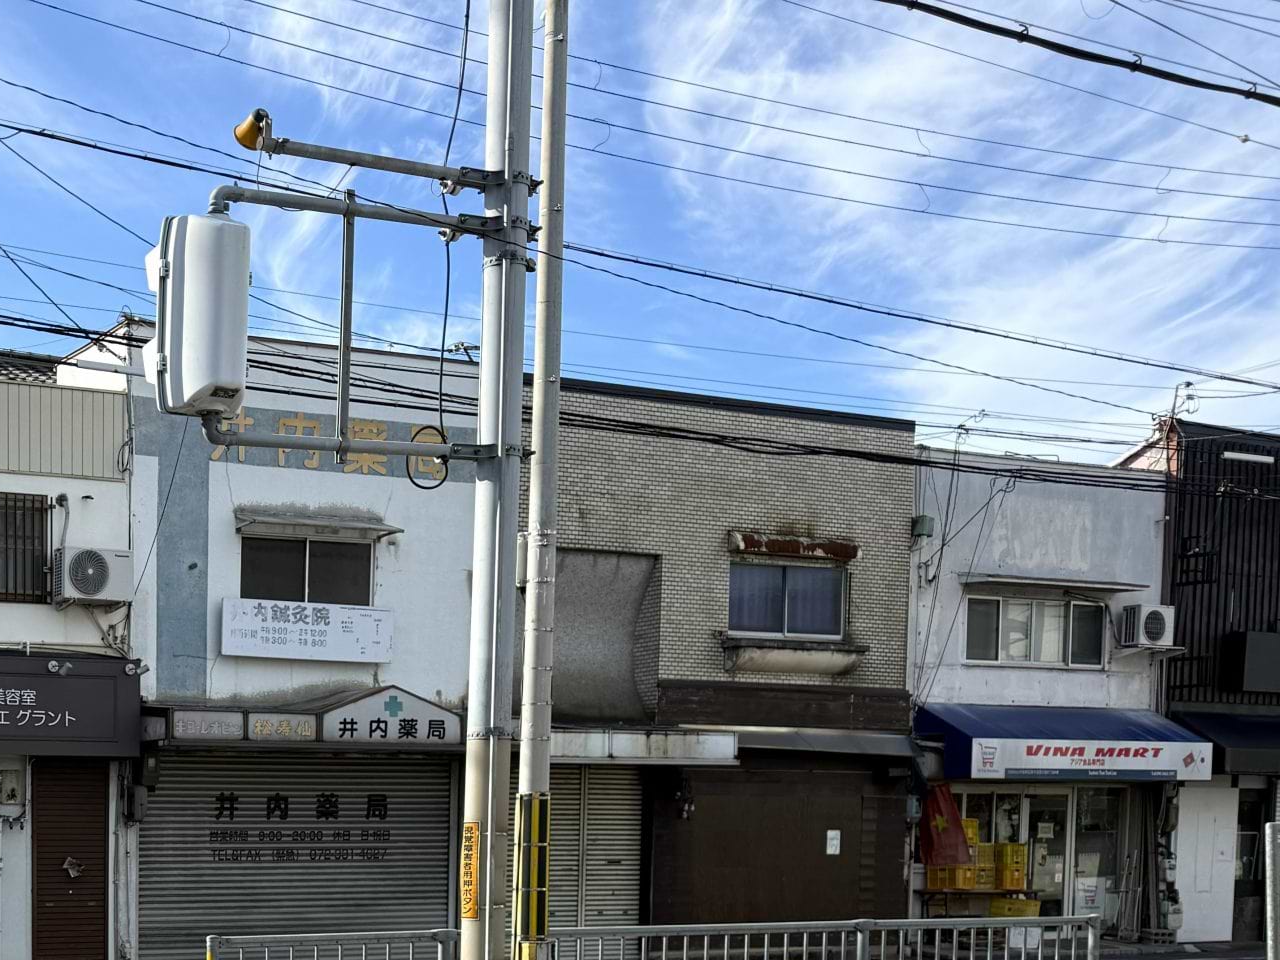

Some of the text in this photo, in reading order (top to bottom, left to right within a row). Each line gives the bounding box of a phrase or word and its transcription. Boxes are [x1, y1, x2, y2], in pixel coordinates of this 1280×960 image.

[232, 602, 330, 626] 内鍼灸院
[16, 710, 76, 727] グラント
[255, 720, 312, 736] 松寿仙
[338, 717, 446, 739] 井内薬局
[1026, 745, 1164, 758] VINA MART
[214, 792, 389, 821] 井内薬局
